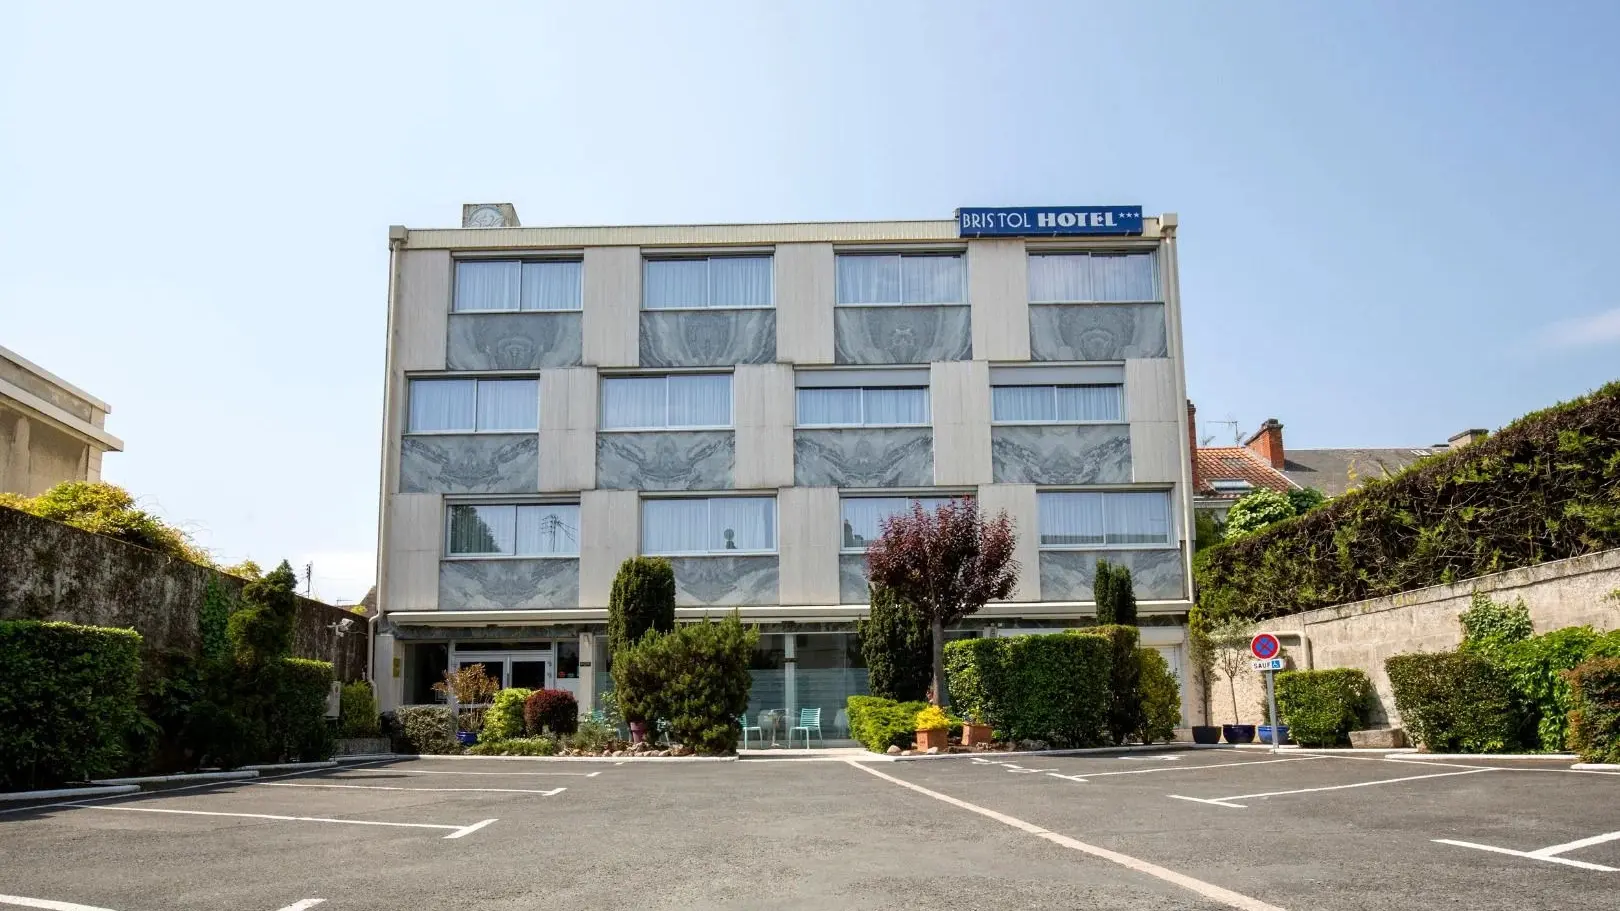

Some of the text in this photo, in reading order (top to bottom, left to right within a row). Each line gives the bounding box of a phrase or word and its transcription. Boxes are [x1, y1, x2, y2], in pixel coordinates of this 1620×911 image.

[962, 211, 1118, 228] BRISTOL HOTEL
[1253, 661, 1270, 669] SAUF
